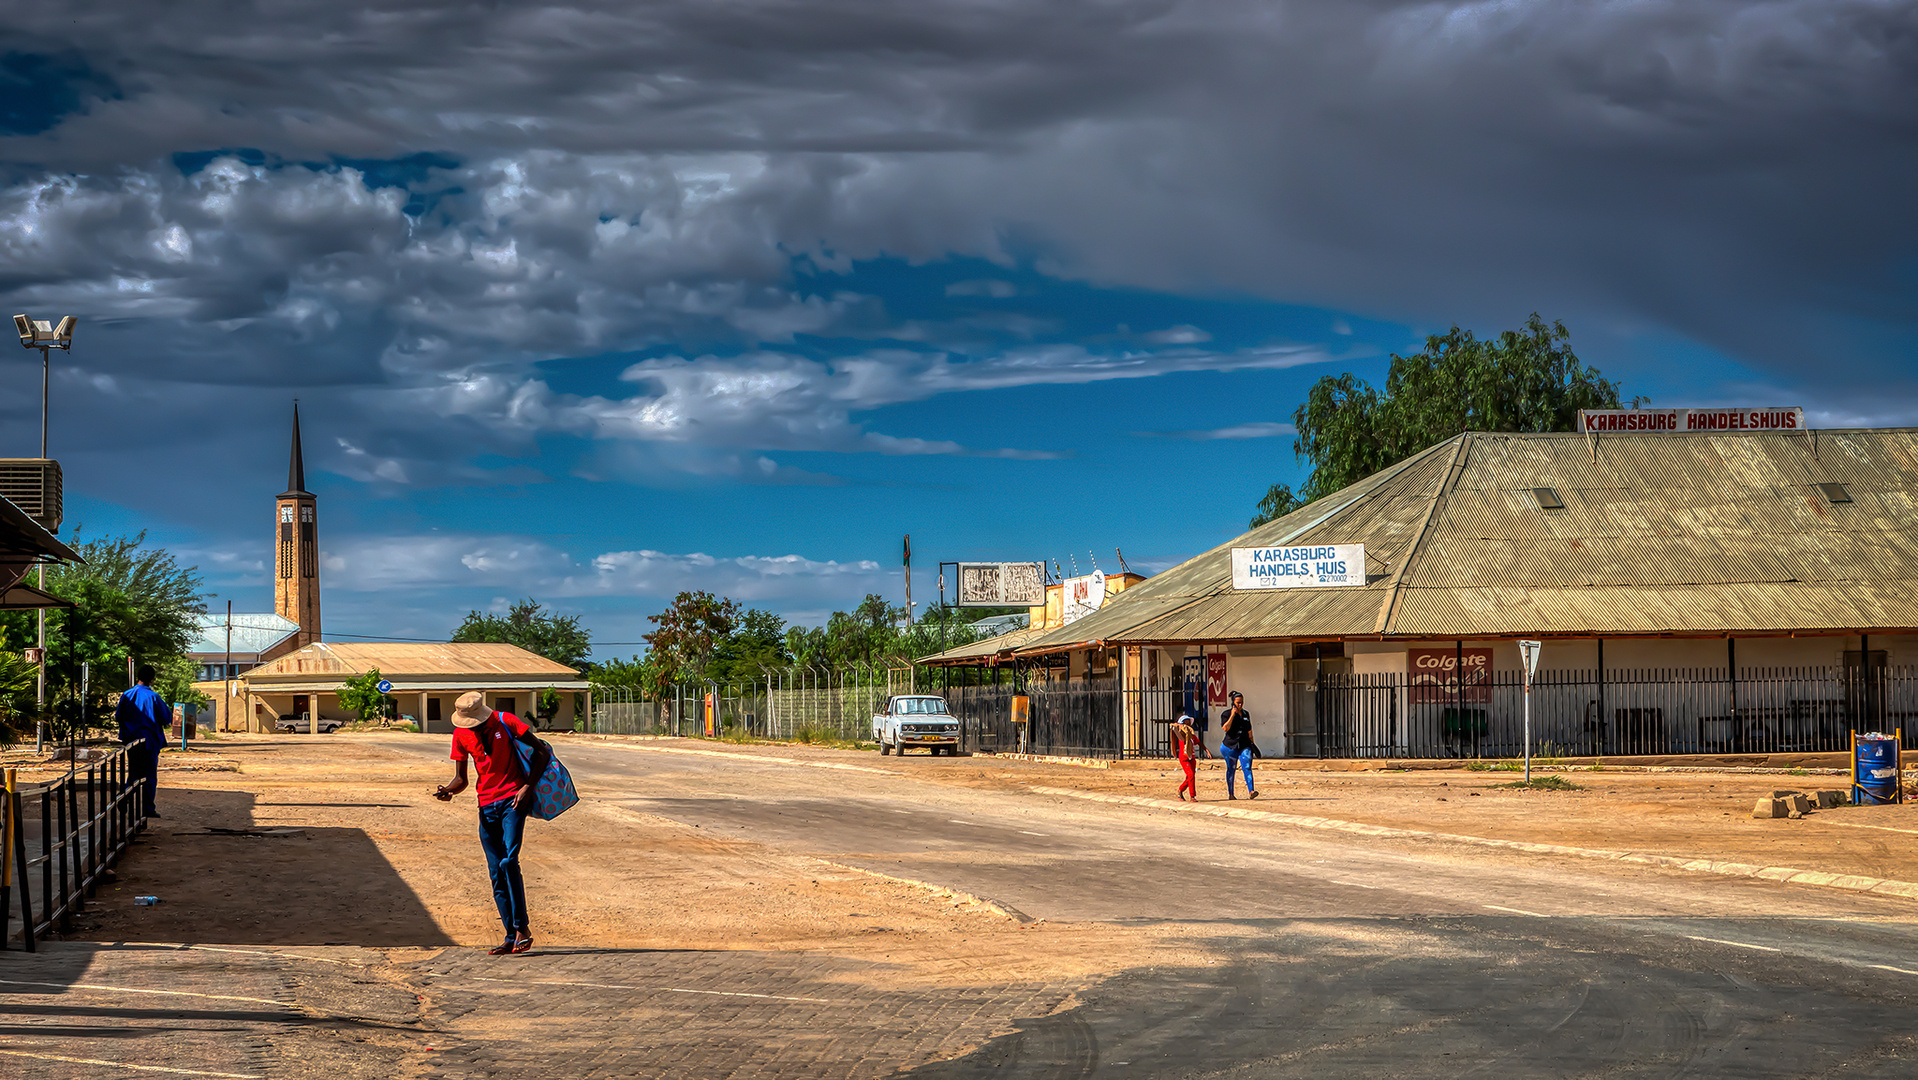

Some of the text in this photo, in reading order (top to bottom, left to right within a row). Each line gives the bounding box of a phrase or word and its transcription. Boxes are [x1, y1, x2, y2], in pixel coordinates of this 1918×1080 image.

[1586, 411, 1797, 431] KARASBURG HANDELSHUIS
[1253, 547, 1336, 562] KARASBURG
[1249, 561, 1347, 577] HANDELS HUIS
[1272, 577, 1277, 586] 2
[1416, 654, 1487, 671] Colgate
